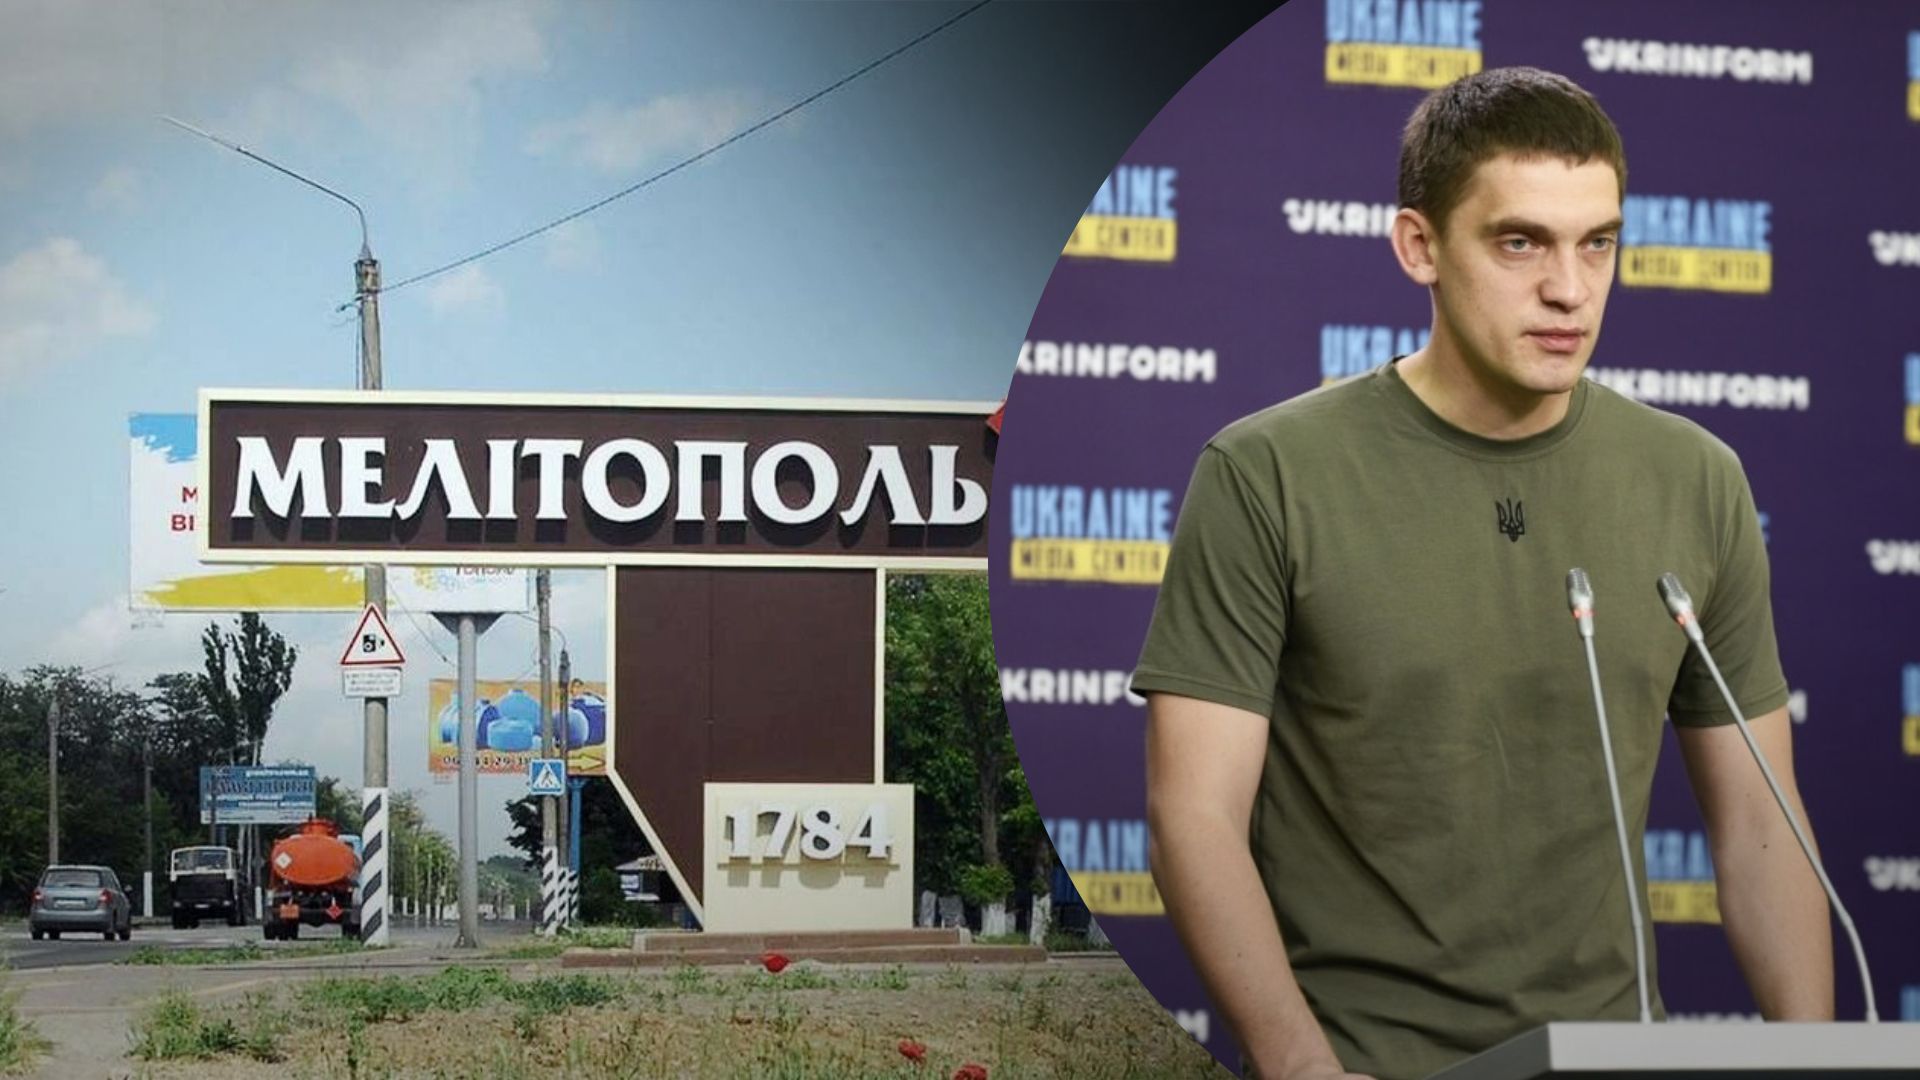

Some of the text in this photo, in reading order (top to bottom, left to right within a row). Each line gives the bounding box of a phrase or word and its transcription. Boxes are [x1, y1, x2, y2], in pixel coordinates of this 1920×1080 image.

[1326, 0, 1482, 52] UKRAINE
[1582, 37, 1813, 84] UKRINFORM
[1622, 194, 1772, 253] UKRAINE
[231, 436, 988, 525] МЕЛІТОПОЛЬ
[1011, 484, 1172, 543] UKRAINE
[725, 800, 895, 861] 1784
